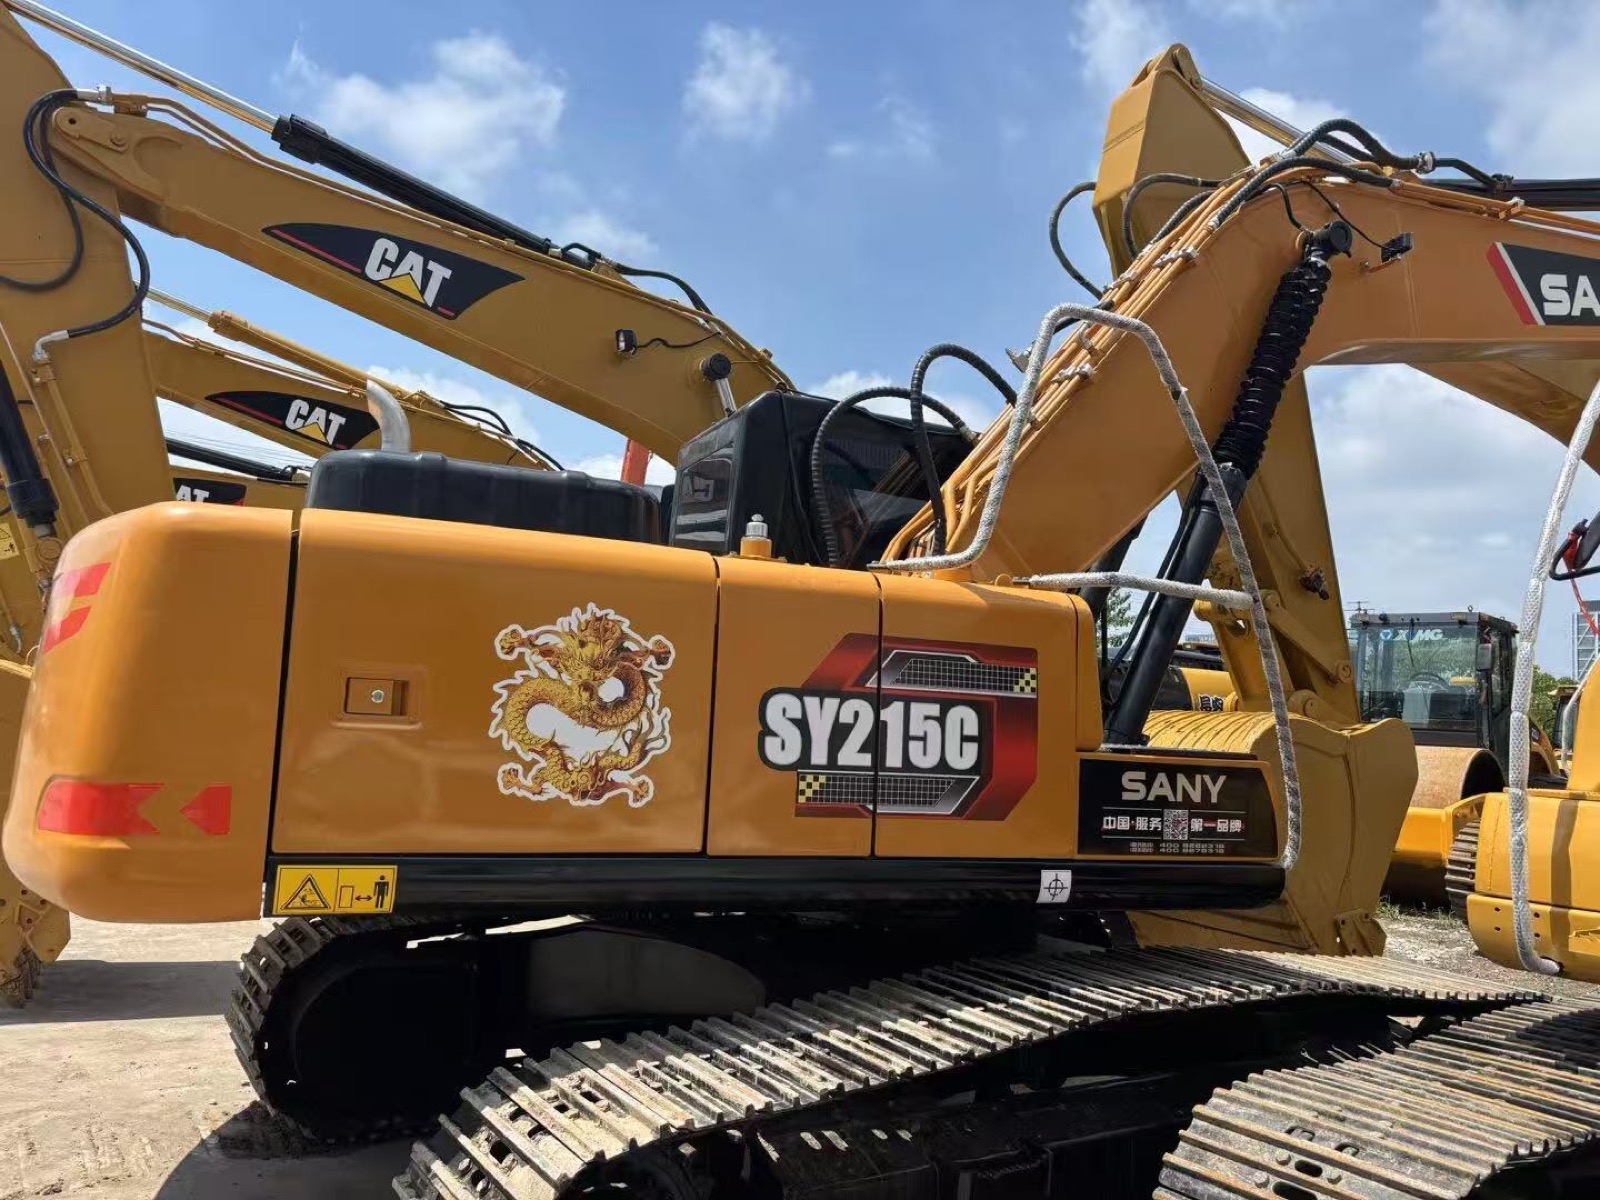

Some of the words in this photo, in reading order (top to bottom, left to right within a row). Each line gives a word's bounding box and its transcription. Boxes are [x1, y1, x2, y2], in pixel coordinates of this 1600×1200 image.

[364, 237, 452, 307] CAT
[284, 398, 347, 446] CAT
[1394, 628, 1444, 642] XMG
[763, 692, 979, 771] SY215C
[1121, 770, 1227, 804] SANY
[1190, 818, 1242, 833] 第一品牌
